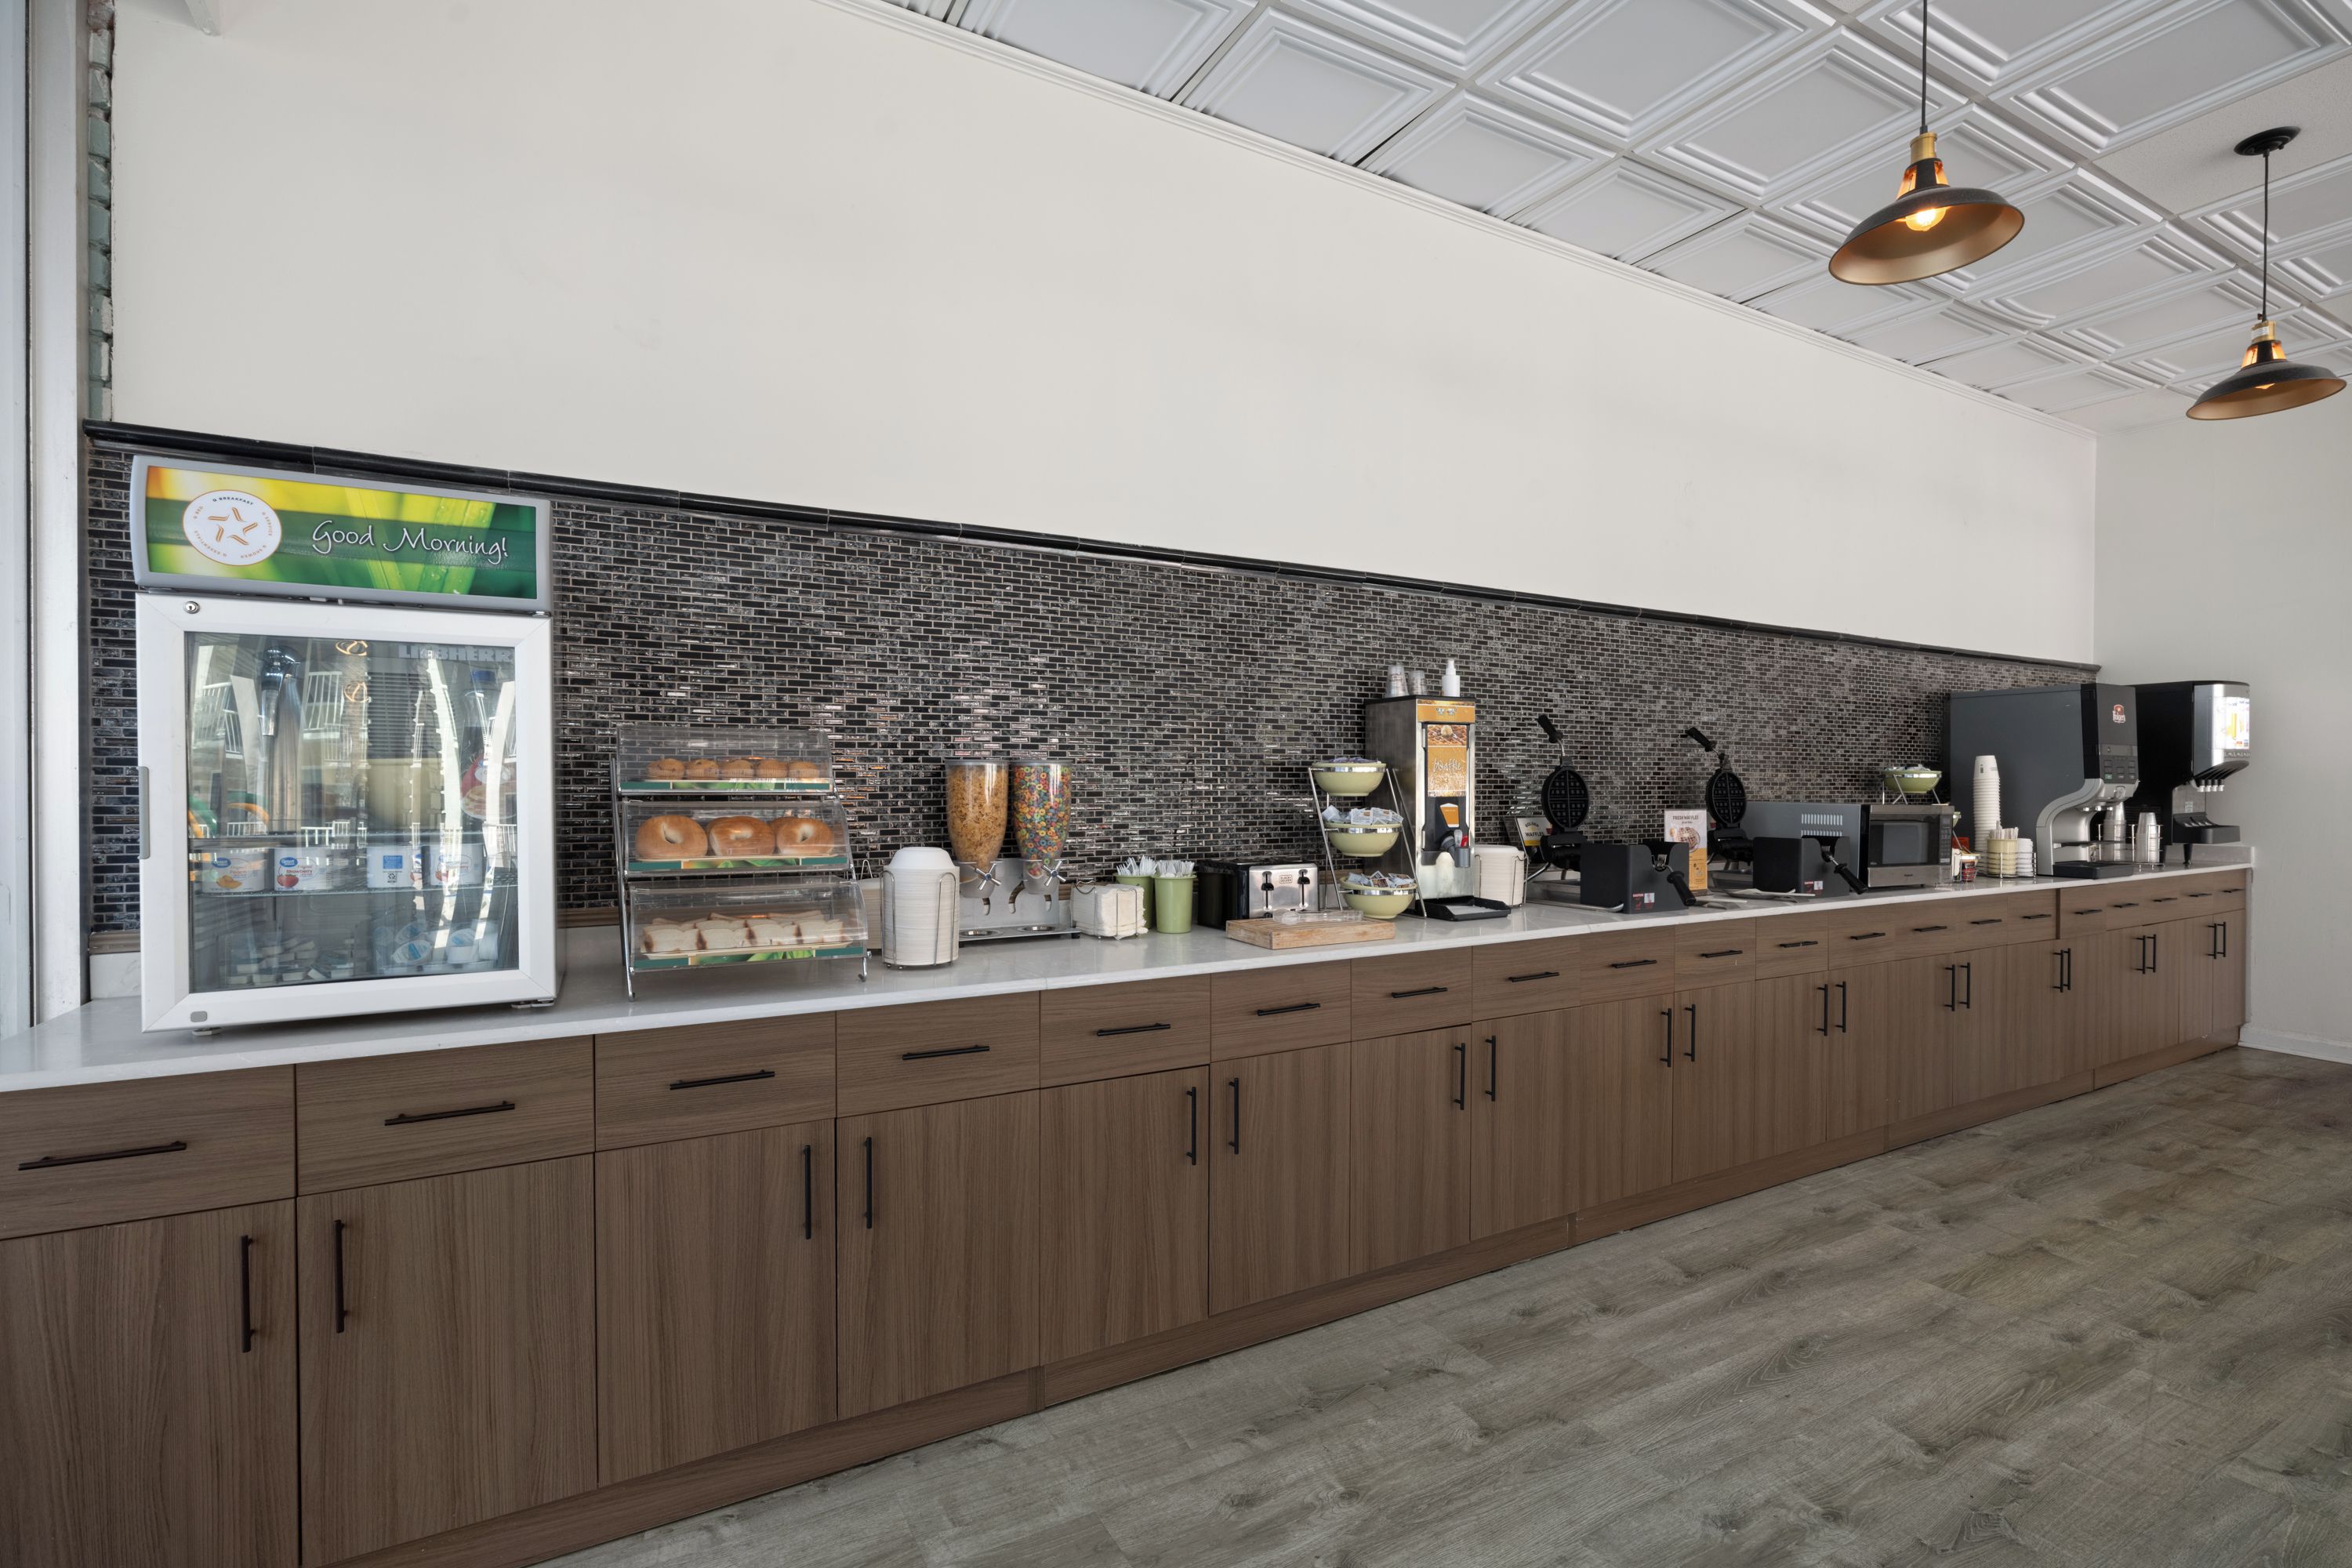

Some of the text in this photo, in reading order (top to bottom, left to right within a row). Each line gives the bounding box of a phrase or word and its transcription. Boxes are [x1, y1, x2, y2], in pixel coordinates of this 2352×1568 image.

[219, 496, 254, 505] BREAKFAST
[312, 520, 509, 564] Good Morning!
